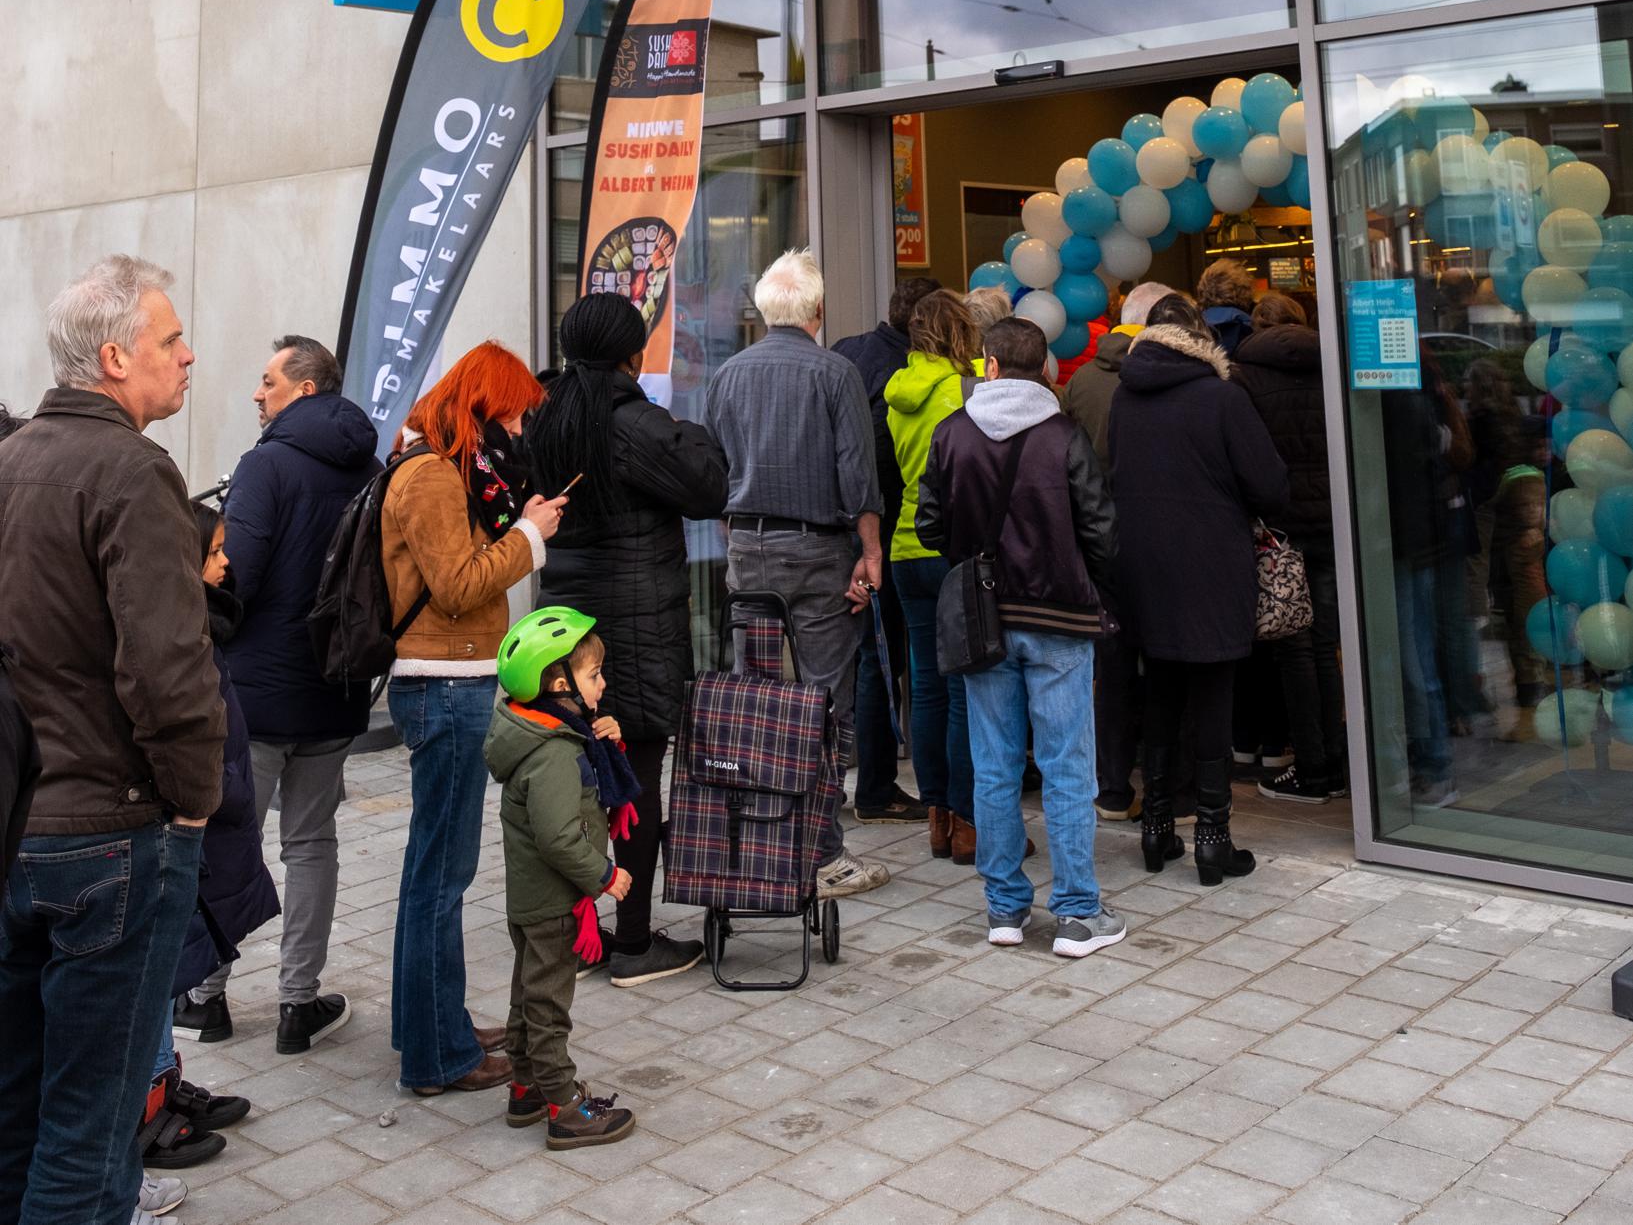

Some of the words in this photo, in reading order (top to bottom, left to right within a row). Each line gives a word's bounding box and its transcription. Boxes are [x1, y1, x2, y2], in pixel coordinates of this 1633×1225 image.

[605, 142, 653, 159] SUSHI
[655, 140, 694, 158] DAILY
[600, 176, 656, 193] ALBERT
[705, 759, 739, 771] W-GIADA
